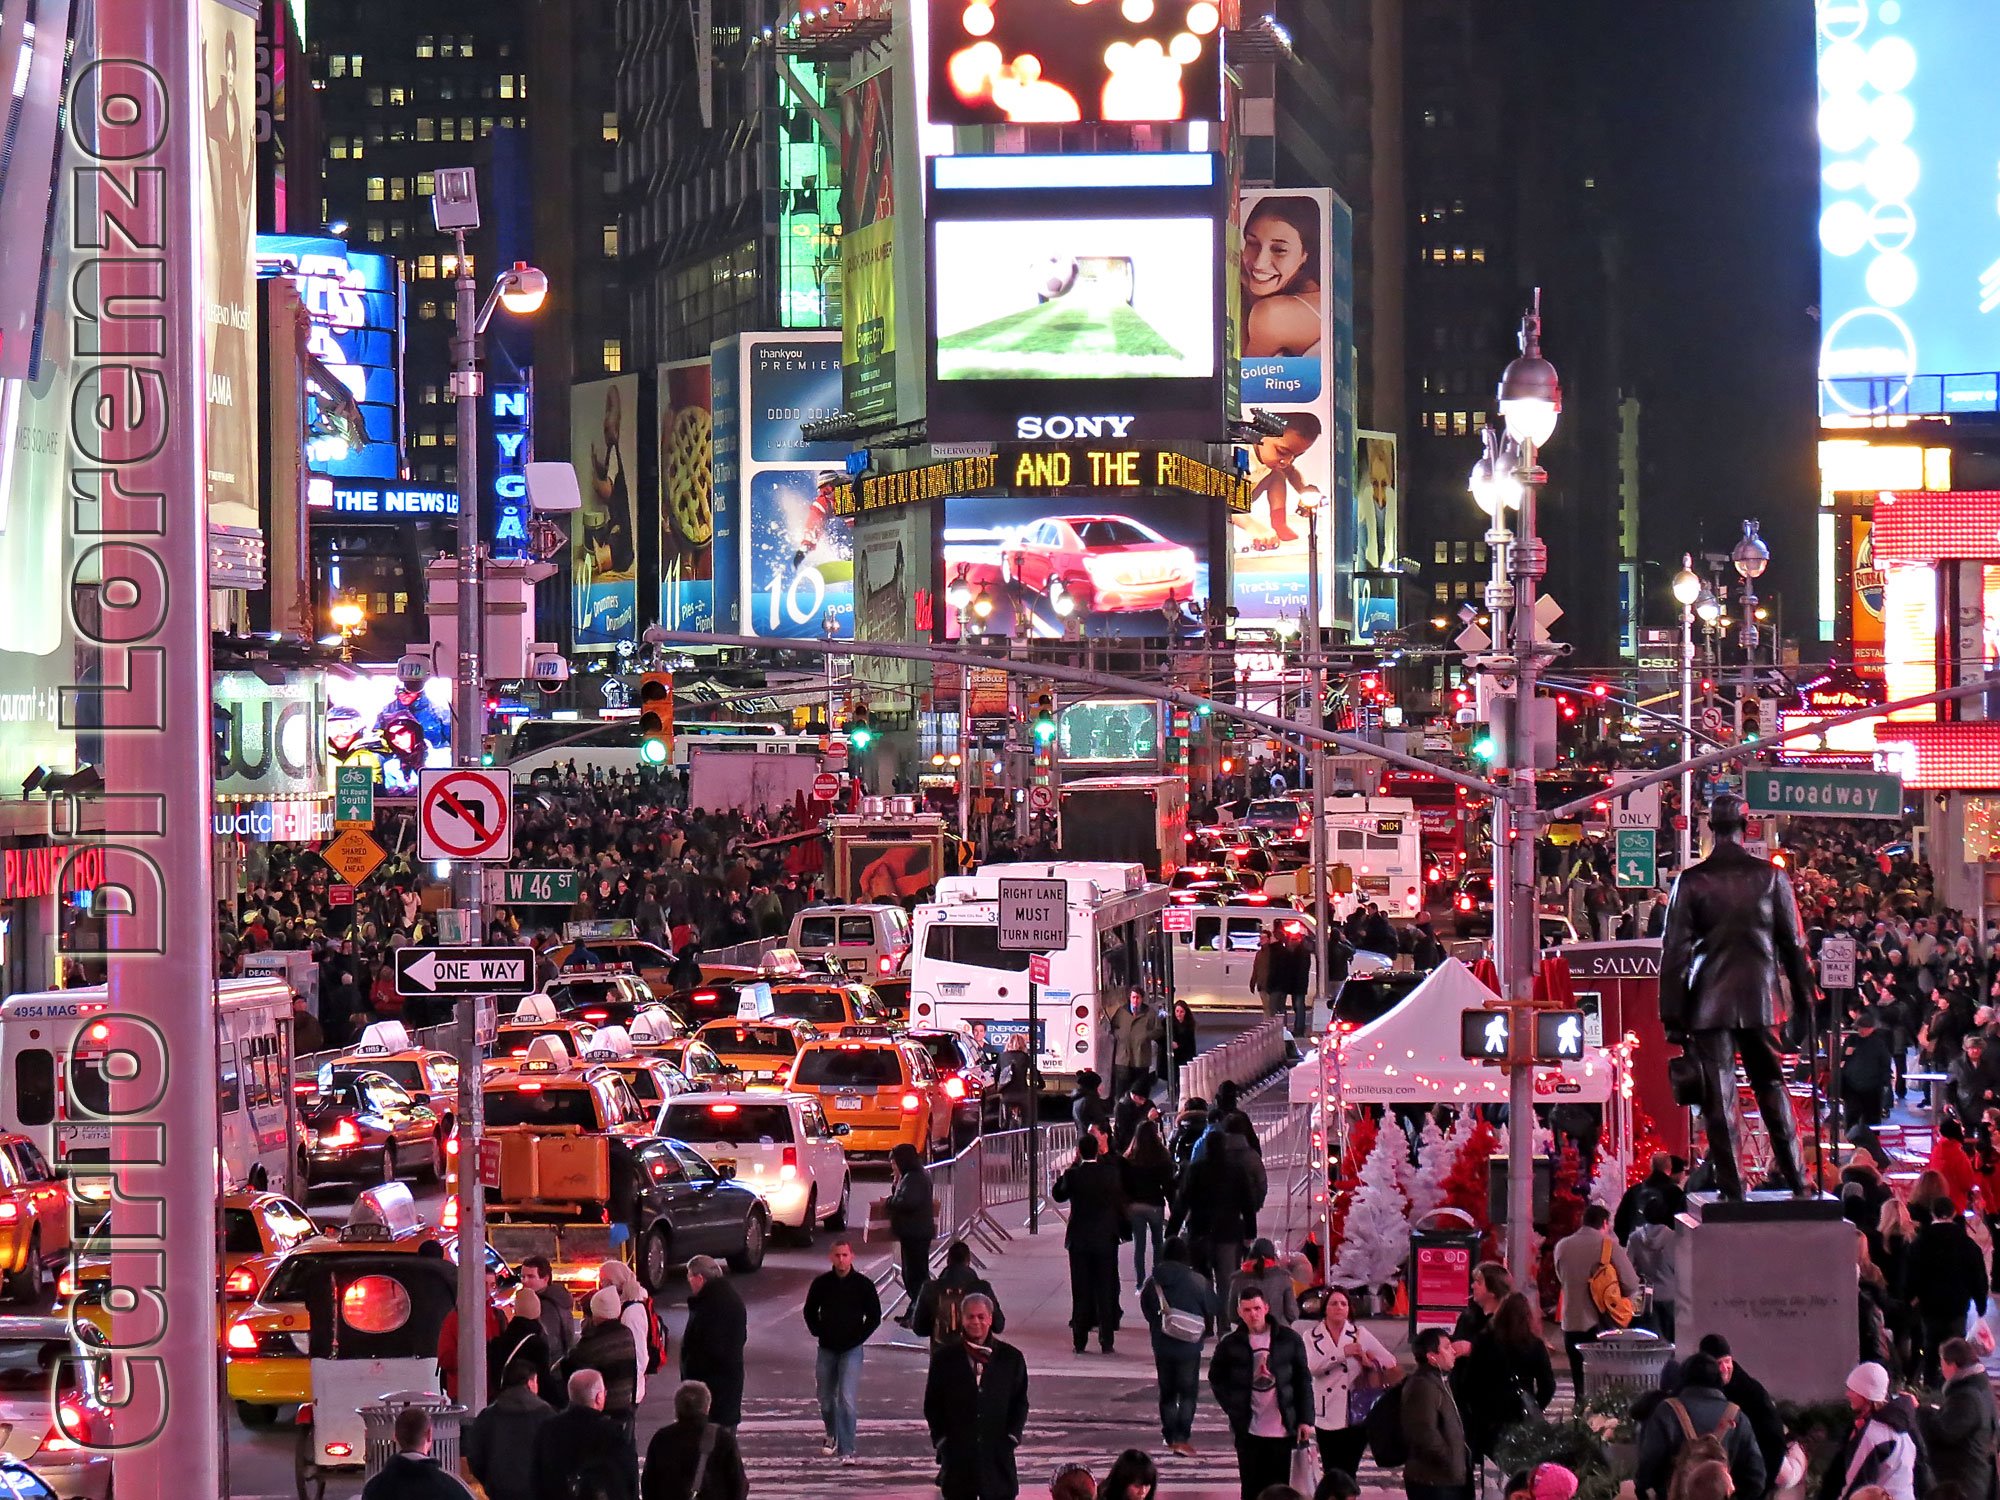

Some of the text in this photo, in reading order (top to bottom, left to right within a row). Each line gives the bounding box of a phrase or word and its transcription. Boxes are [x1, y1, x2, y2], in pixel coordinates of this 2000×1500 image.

[760, 349, 803, 359] thankyou
[760, 361, 841, 371] PREMIER
[1240, 363, 1284, 380] Golden
[1265, 378, 1301, 392] Rings
[1017, 415, 1135, 439] SONY
[933, 444, 990, 456] SHERWOOD
[1016, 452, 1071, 487] AND
[1087, 451, 1141, 486] THE
[334, 491, 459, 514] THE NEWS LE
[664, 552, 681, 631] 11
[1238, 580, 1280, 594] Tracks
[764, 566, 825, 631] 10
[1265, 593, 1308, 607] Laying
[535, 662, 558, 676] NYPD
[973, 675, 1003, 683] SCROLLS
[1767, 779, 1879, 811] Broadway
[1619, 813, 1652, 825] ONLY
[341, 848, 367, 856] SHARED
[5, 846, 69, 899] PLANET
[344, 865, 365, 873] AHEAD
[510, 874, 573, 900] W 46 ST
[1003, 887, 1063, 901] RIGHT LANE
[1015, 908, 1050, 921] MUST
[1002, 929, 1064, 942] TURN RIGHT
[433, 962, 519, 980] ONE WAY
[1826, 963, 1850, 972] WALK
[1828, 973, 1848, 983] BIKE
[14, 1005, 78, 1018] 4954 MAG
